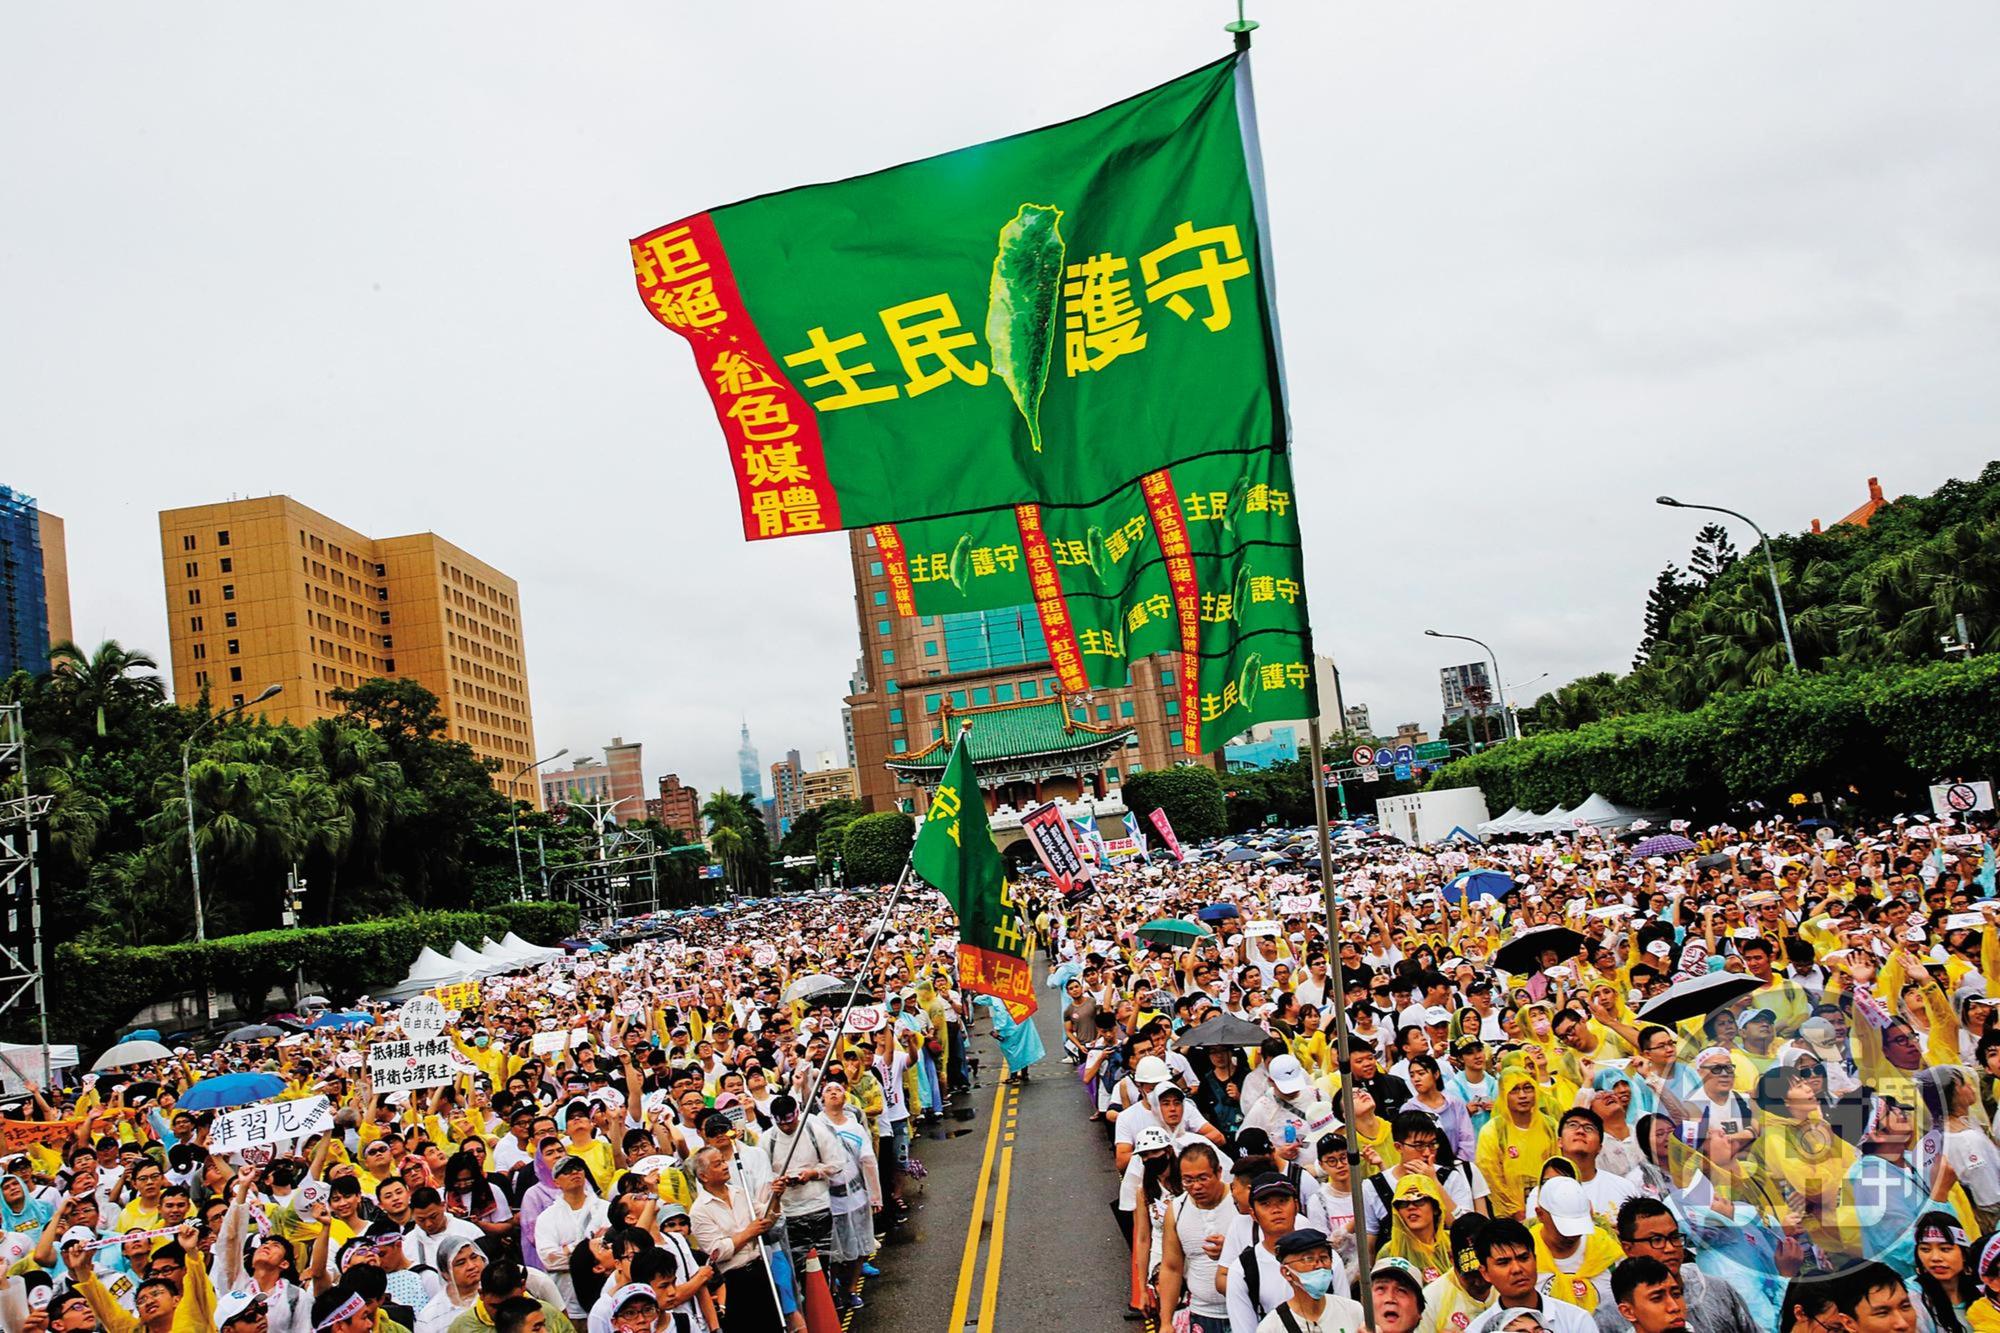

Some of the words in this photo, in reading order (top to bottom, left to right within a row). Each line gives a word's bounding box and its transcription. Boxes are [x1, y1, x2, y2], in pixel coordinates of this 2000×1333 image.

[632, 226, 728, 328] 拒絕
[711, 350, 826, 537] 紅色媒體
[403, 1017, 441, 1030] 自由民主
[374, 1064, 449, 1087] 捍衛台灣民主
[212, 1102, 300, 1145] 維習尼
